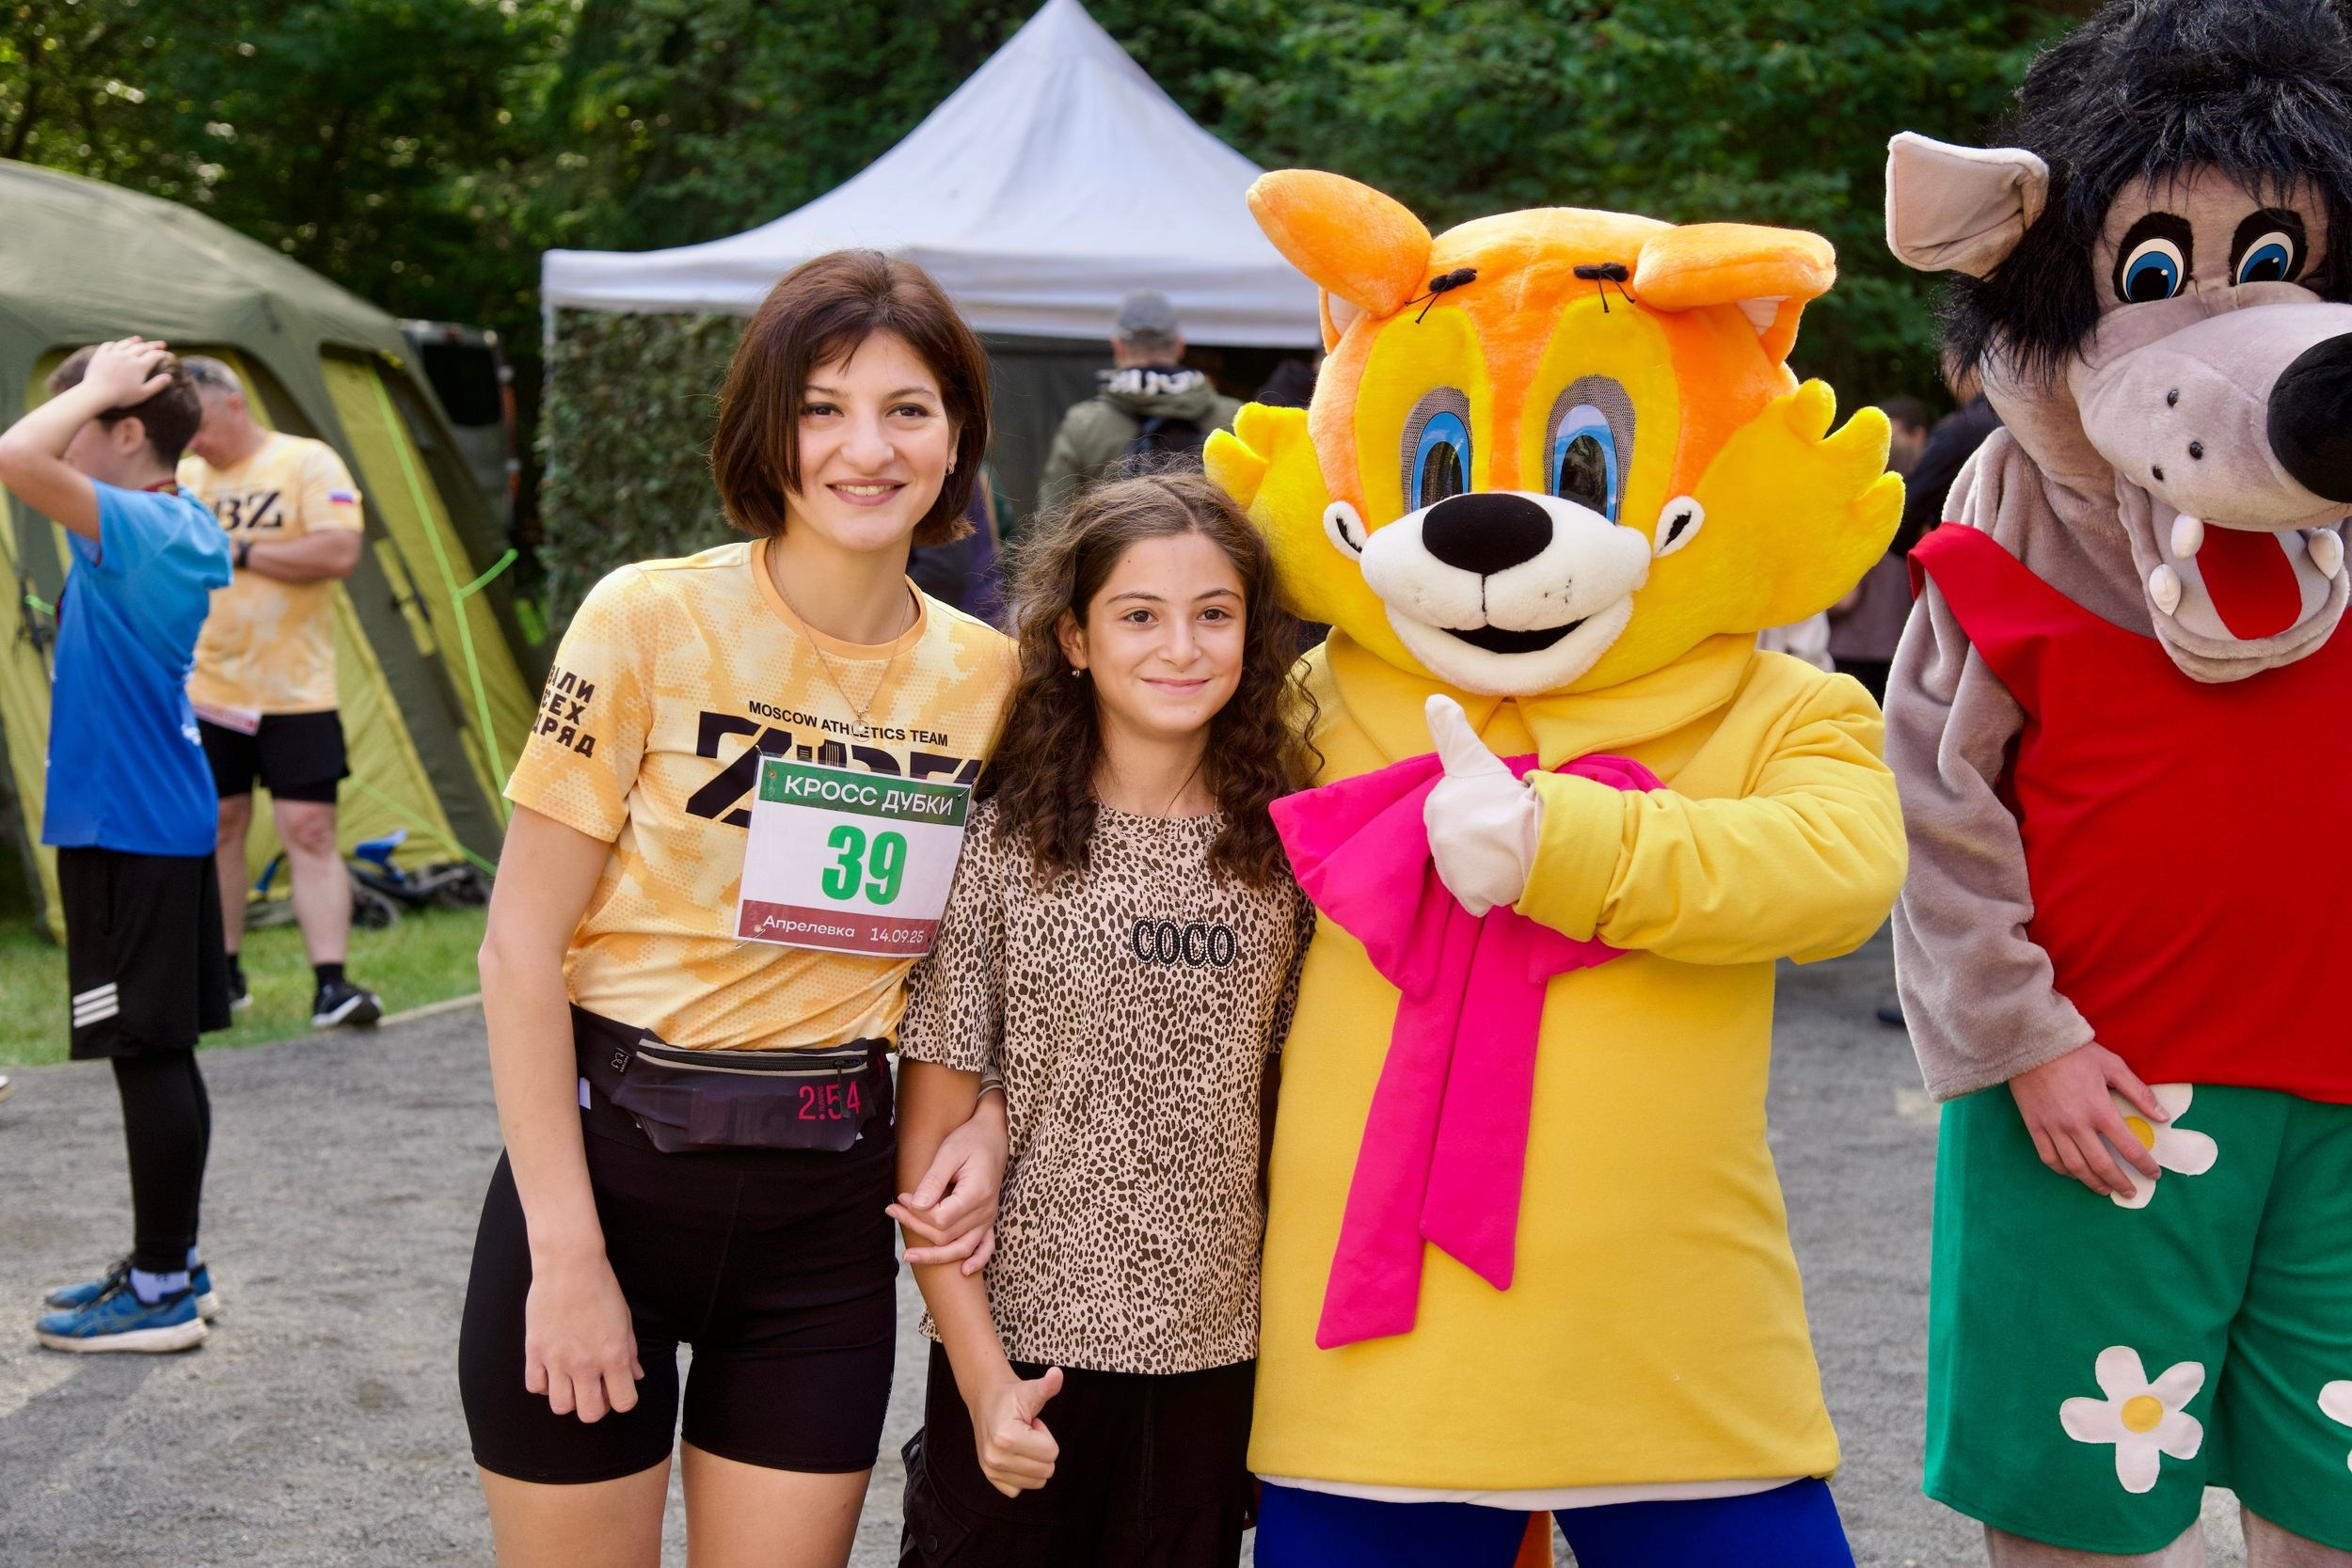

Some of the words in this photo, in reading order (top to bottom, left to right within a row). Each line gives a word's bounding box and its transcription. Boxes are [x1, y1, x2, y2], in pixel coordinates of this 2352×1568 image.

[749, 700, 818, 727] MOSCOW
[821, 719, 906, 740] ATHLETICS
[910, 729, 948, 747] TEAM
[784, 774, 879, 806] КРОСС
[881, 789, 953, 816] ДУБКИ
[821, 824, 908, 906] 39
[762, 914, 855, 938] Апрелевка
[869, 927, 925, 944] 14.09.25
[1131, 916, 1238, 970] COCO
